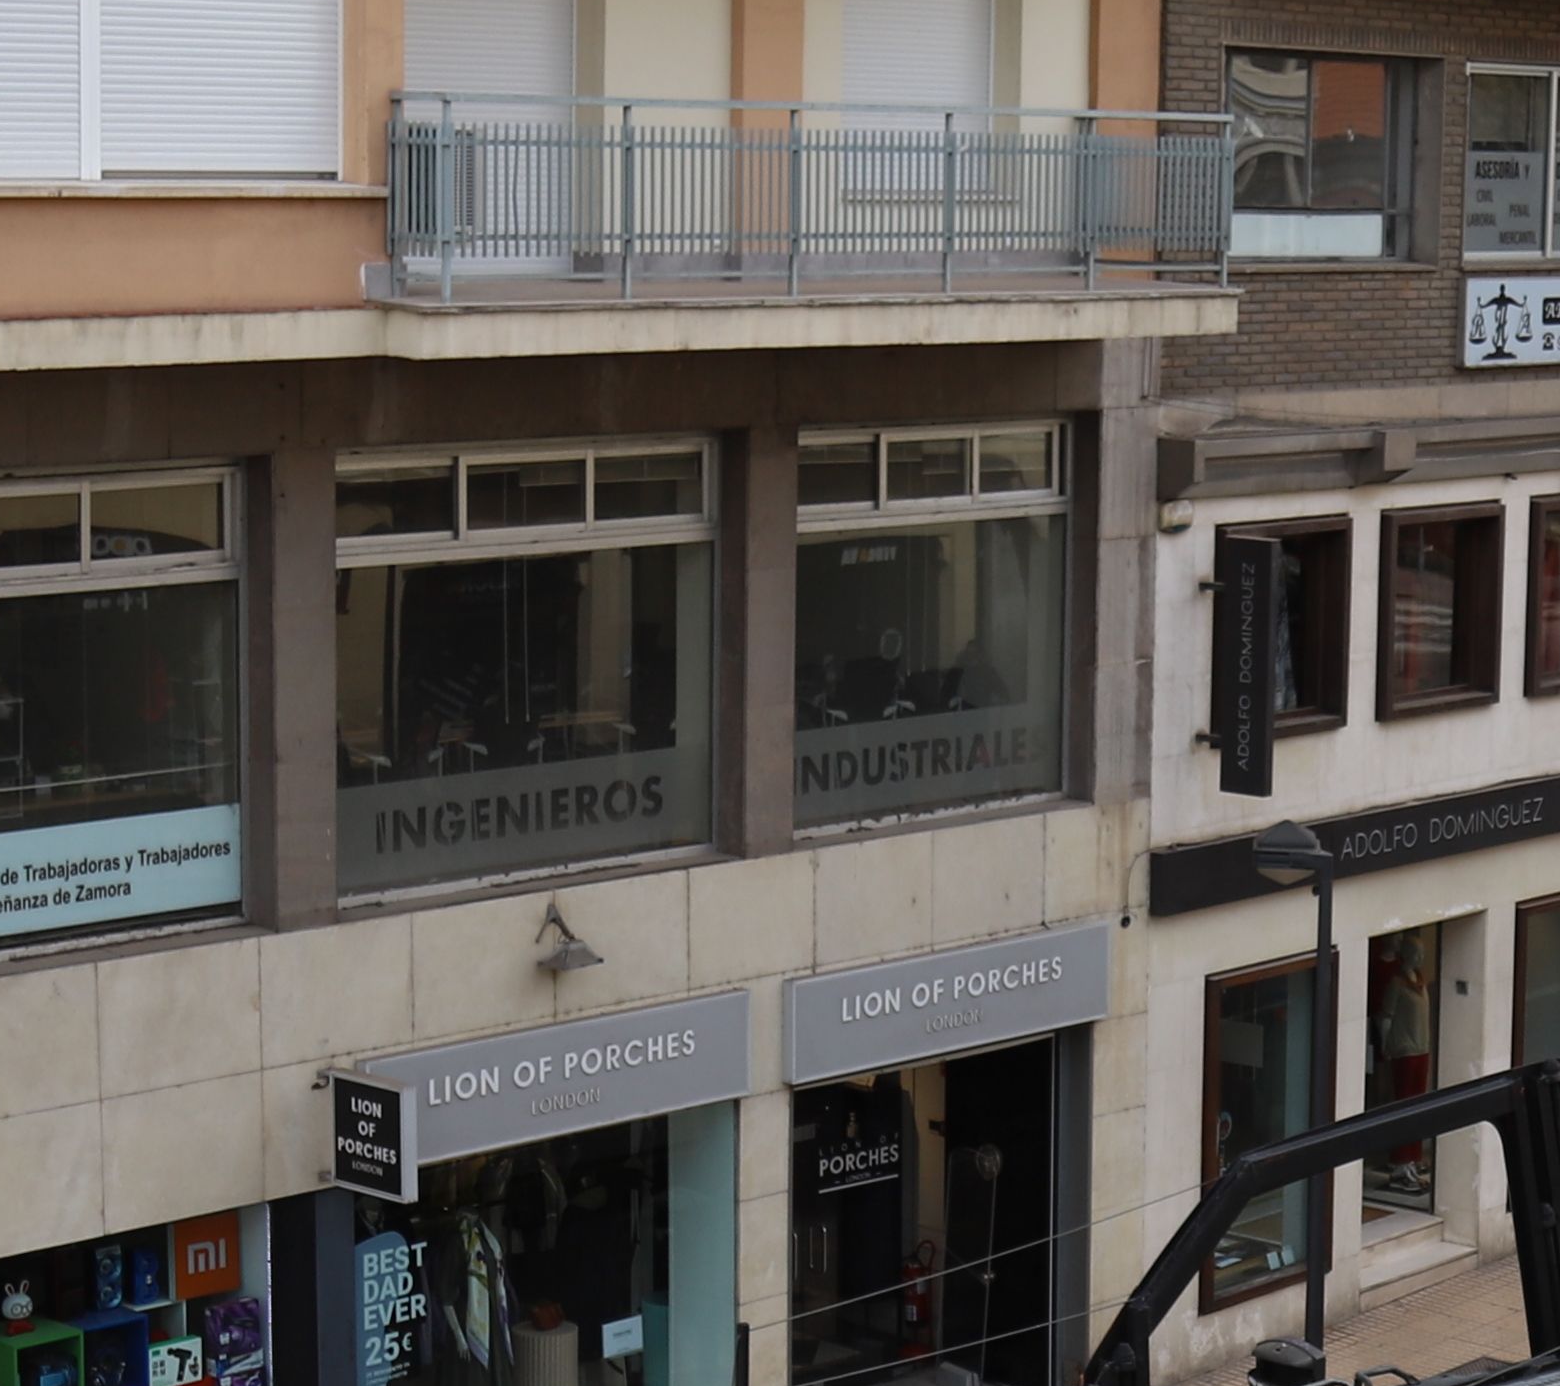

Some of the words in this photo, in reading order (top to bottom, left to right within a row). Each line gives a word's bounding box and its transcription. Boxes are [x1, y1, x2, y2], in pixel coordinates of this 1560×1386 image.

[375, 775, 664, 855] INGENIEROS
[1341, 822, 1418, 861] ADOLFO
[1429, 797, 1545, 845] DOMINGUEZ
[0, 868, 19, 886] de
[23, 854, 120, 884] Trabajadoras
[124, 853, 133, 873] y
[138, 840, 231, 868] Trabajadores
[53, 888, 71, 907] de
[75, 880, 131, 903] Zamora
[842, 987, 901, 1023] LION
[912, 979, 945, 1009] OF
[953, 956, 1063, 1001] PORCHES
[925, 1008, 984, 1034] LONDON
[428, 1065, 500, 1106] LION
[513, 1056, 552, 1089] OF
[564, 1029, 696, 1079] PORCHES
[351, 1096, 383, 1120] LION
[531, 1086, 602, 1116] LONDON
[358, 1120, 376, 1139] OF
[337, 1135, 397, 1165] PORCHES
[819, 1144, 900, 1178] PORCHES
[351, 1160, 383, 1178] LONDON
[363, 1241, 428, 1279] BEST
[363, 1271, 414, 1305] DAD
[363, 1293, 427, 1331] EVER
[364, 1331, 413, 1367] 25€
